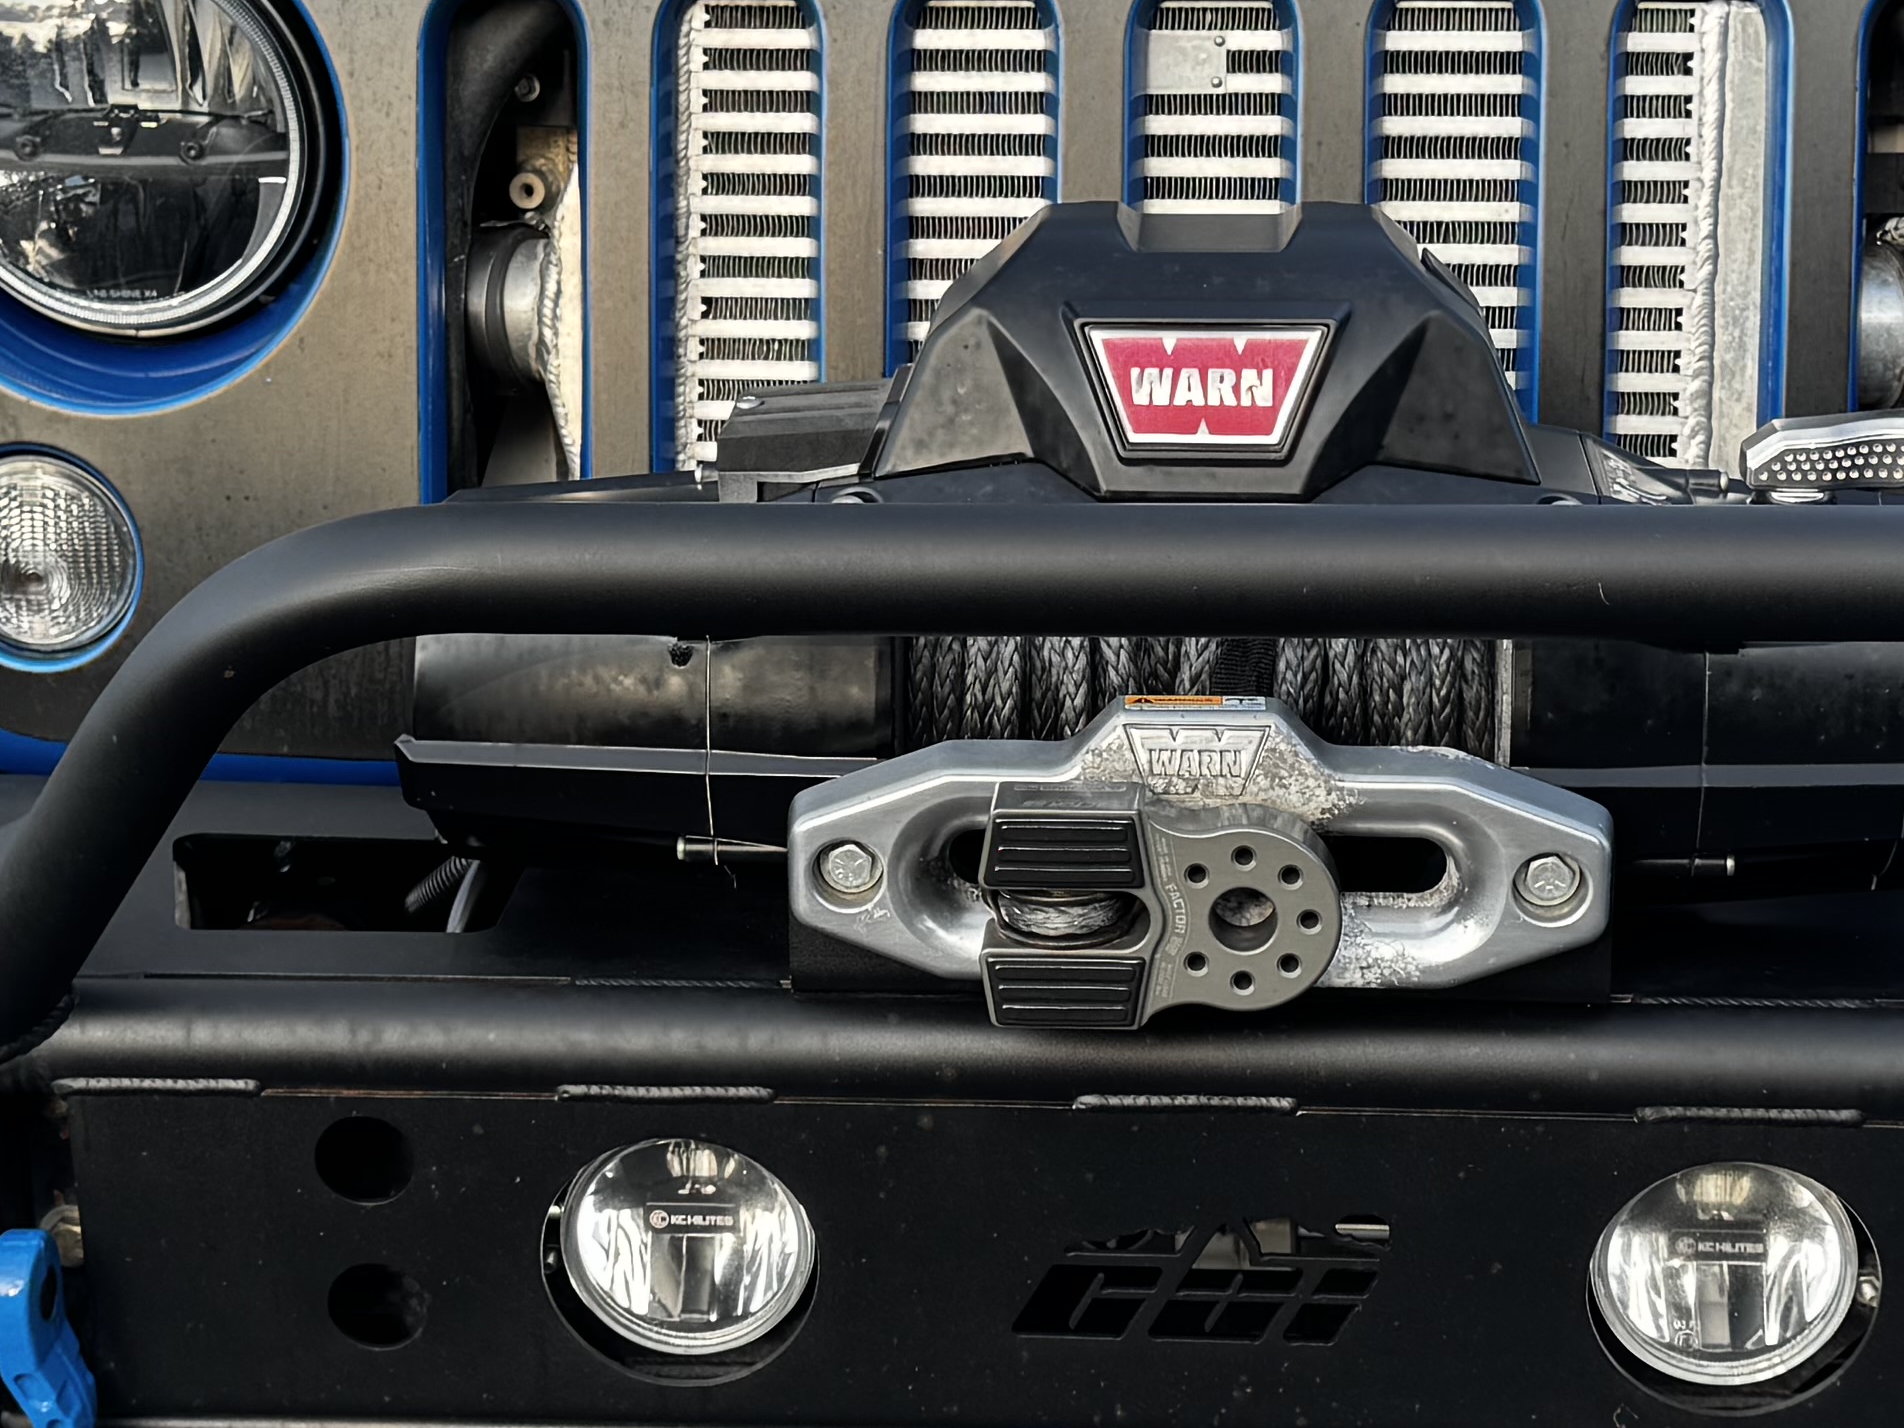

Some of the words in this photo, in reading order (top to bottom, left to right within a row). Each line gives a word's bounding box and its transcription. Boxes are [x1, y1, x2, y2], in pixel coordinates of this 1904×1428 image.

[1130, 366, 1274, 408] WARN
[1148, 748, 1245, 778] WARN
[1164, 883, 1187, 934] FACTOR
